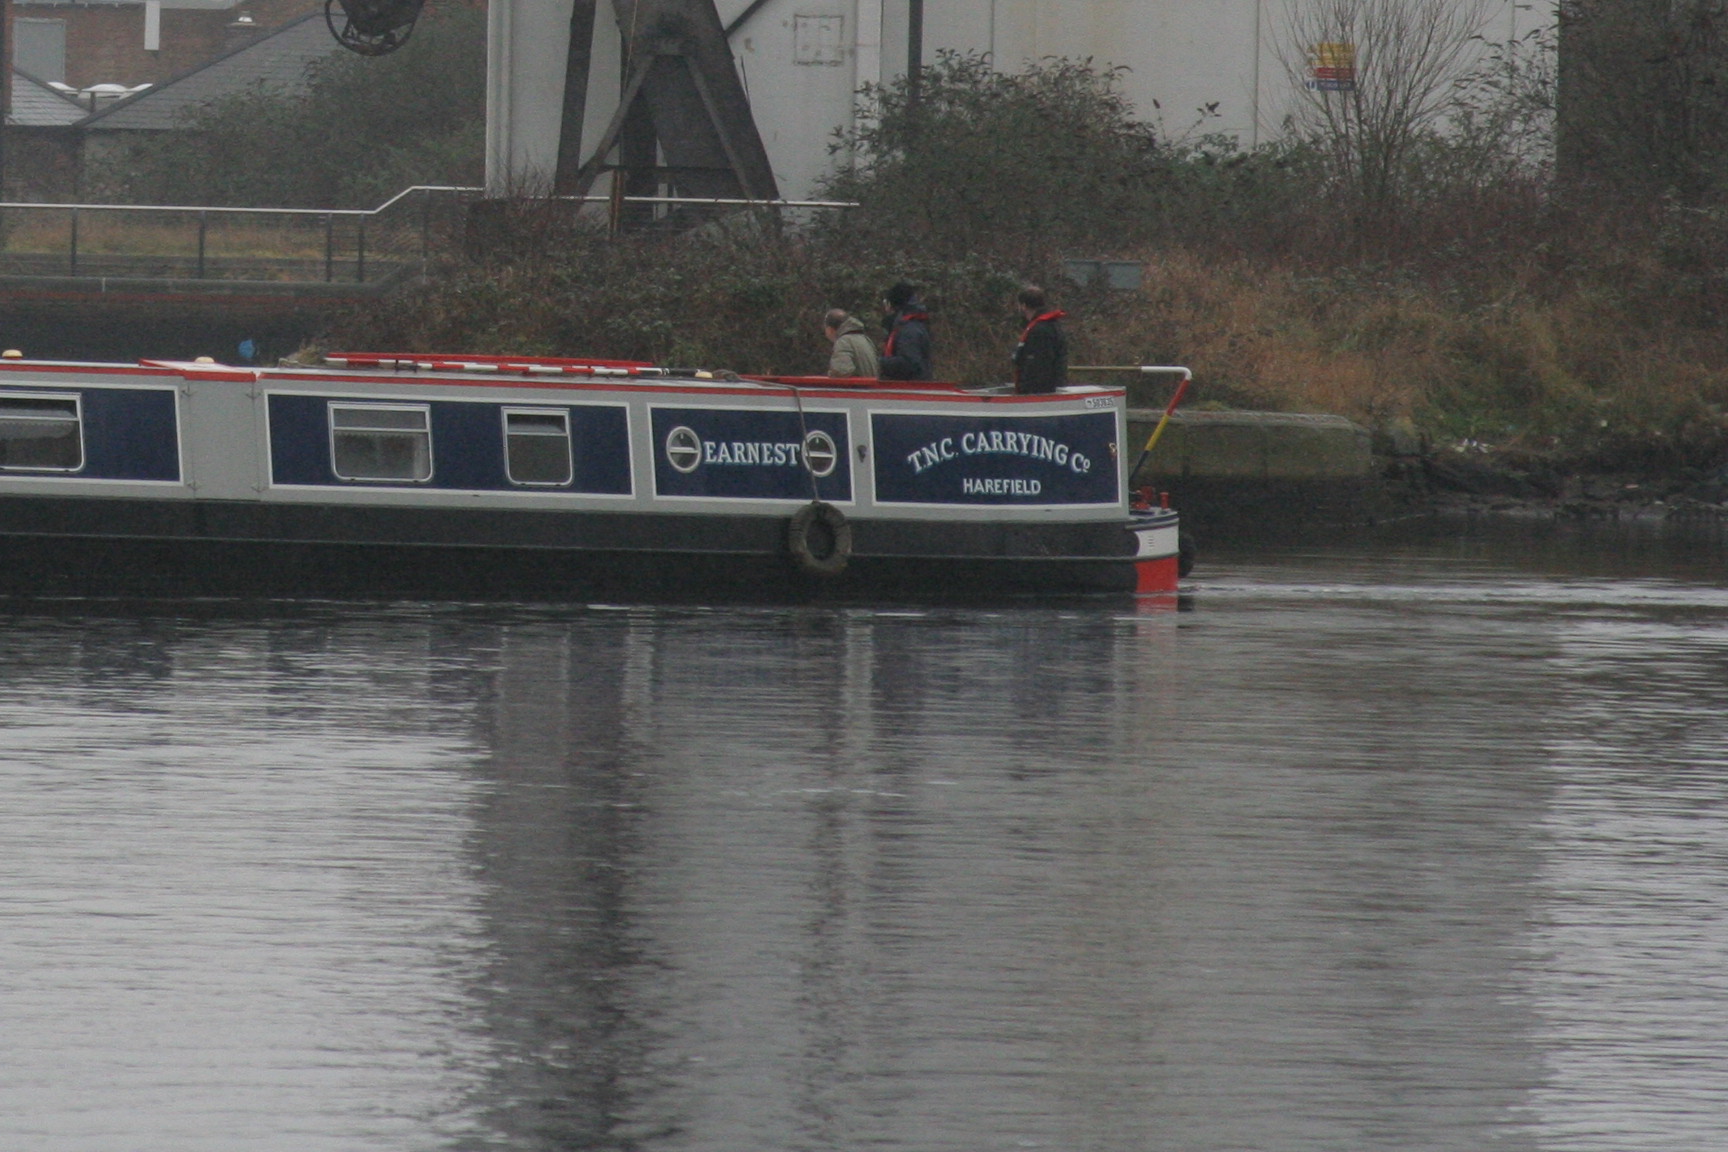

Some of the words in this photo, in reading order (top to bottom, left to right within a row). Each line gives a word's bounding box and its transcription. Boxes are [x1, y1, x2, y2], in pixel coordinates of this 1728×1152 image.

[703, 440, 801, 466] EARNEST
[960, 430, 1069, 466] CARRYING
[962, 478, 1042, 495] HAREFIELD
